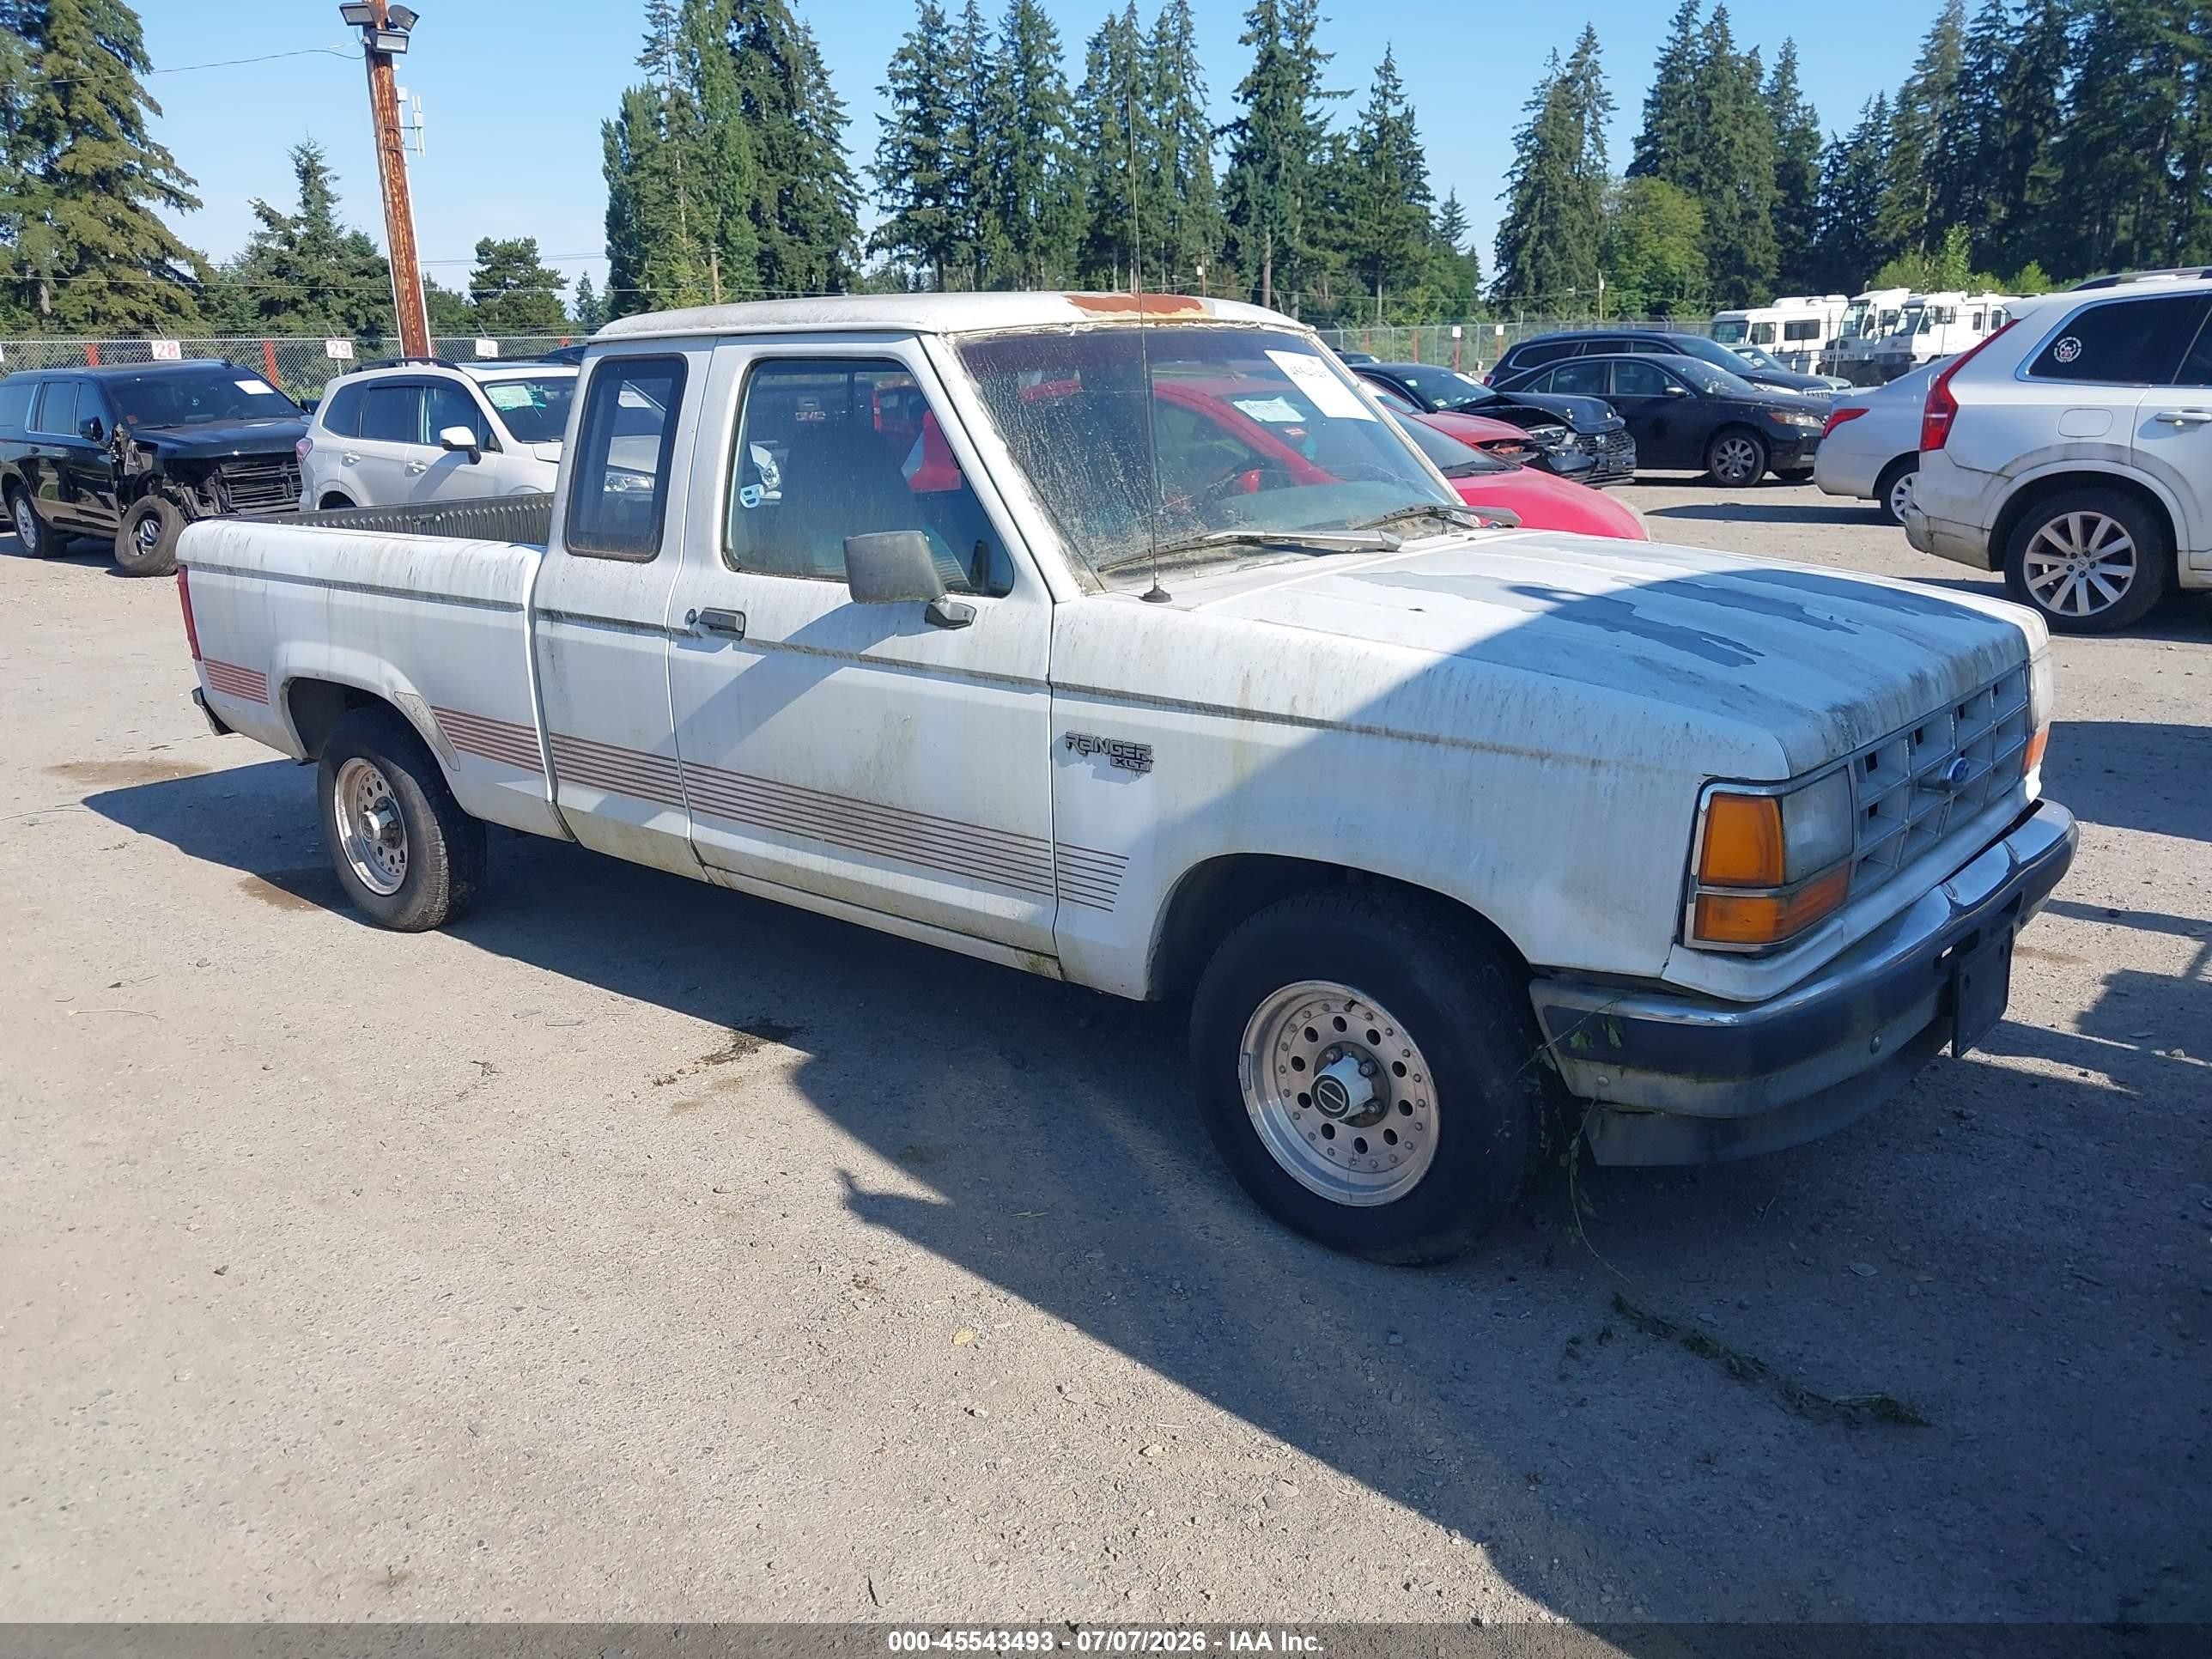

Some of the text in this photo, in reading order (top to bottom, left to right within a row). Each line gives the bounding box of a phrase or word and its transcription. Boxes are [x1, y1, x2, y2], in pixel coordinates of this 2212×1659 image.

[155, 343, 178, 357] 28
[330, 343, 349, 356] 29
[1115, 758, 1144, 769] XLT
